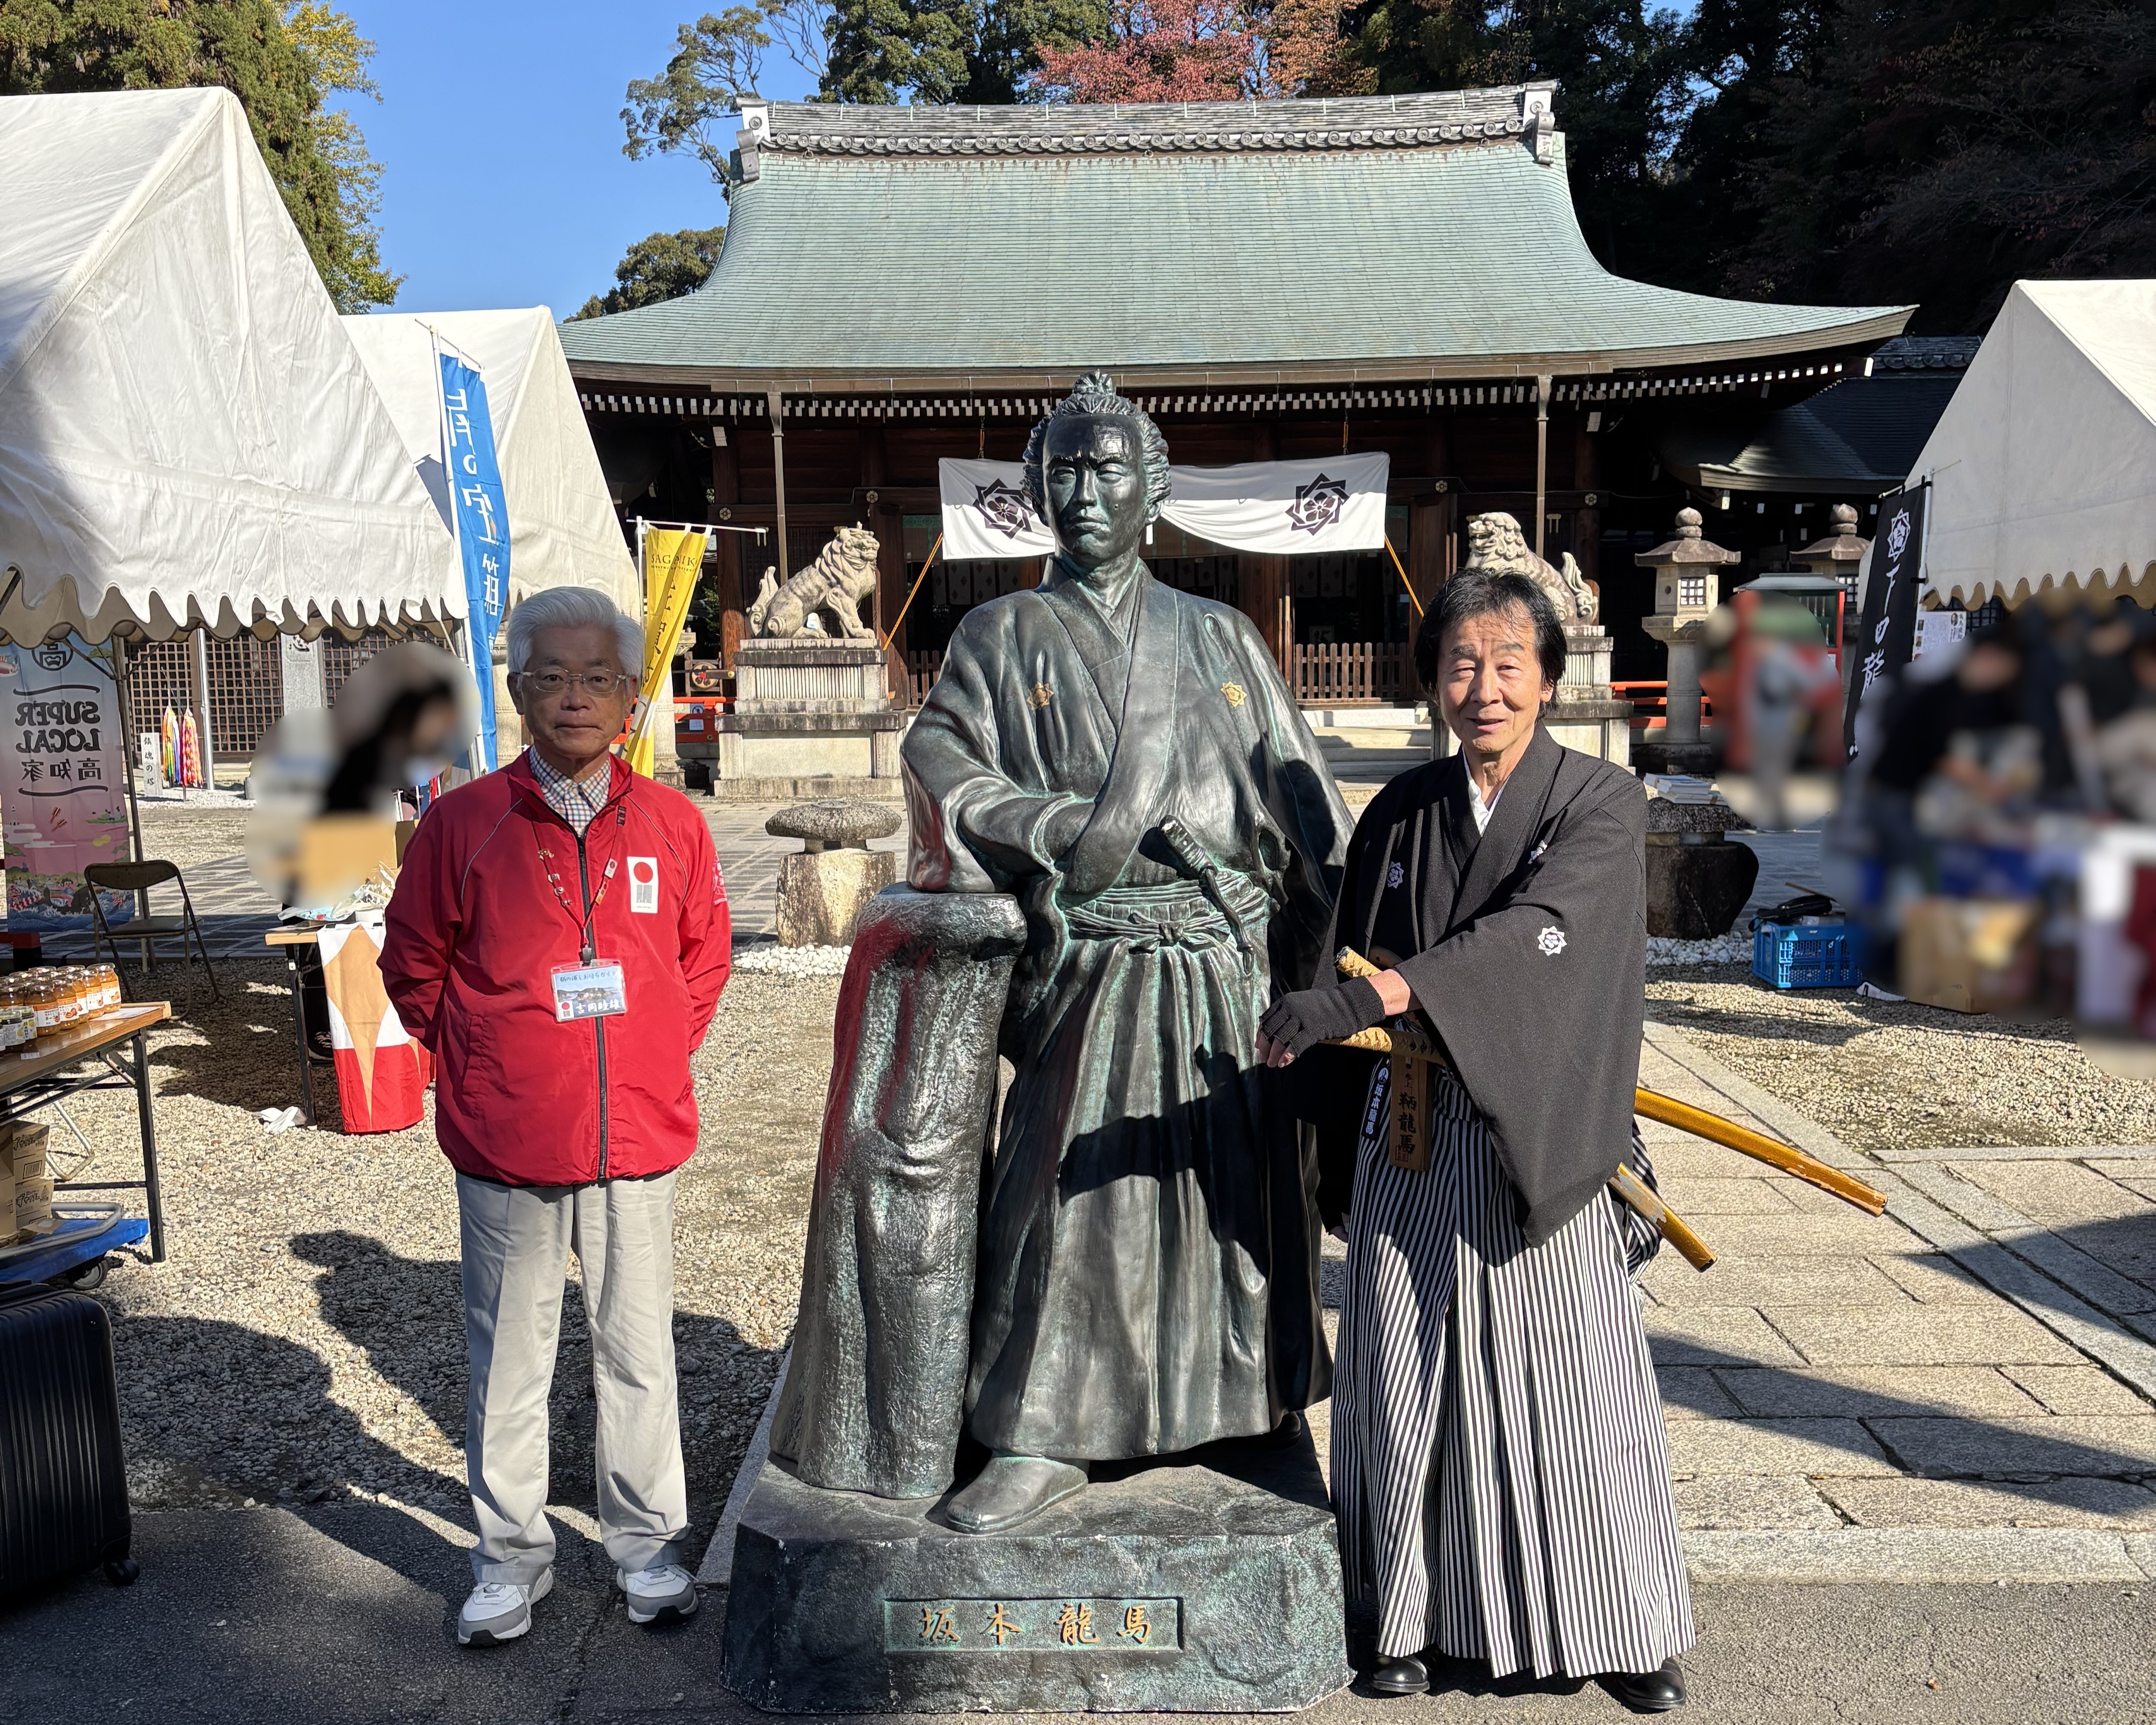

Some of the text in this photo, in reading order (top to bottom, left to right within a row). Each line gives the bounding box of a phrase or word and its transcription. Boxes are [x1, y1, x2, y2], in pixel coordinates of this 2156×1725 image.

[1365, 1083, 1384, 1135] 坂本龍馬
[1398, 1092, 1417, 1154] 鞆龍馬
[919, 1602, 1152, 1645] 坂本龍馬
